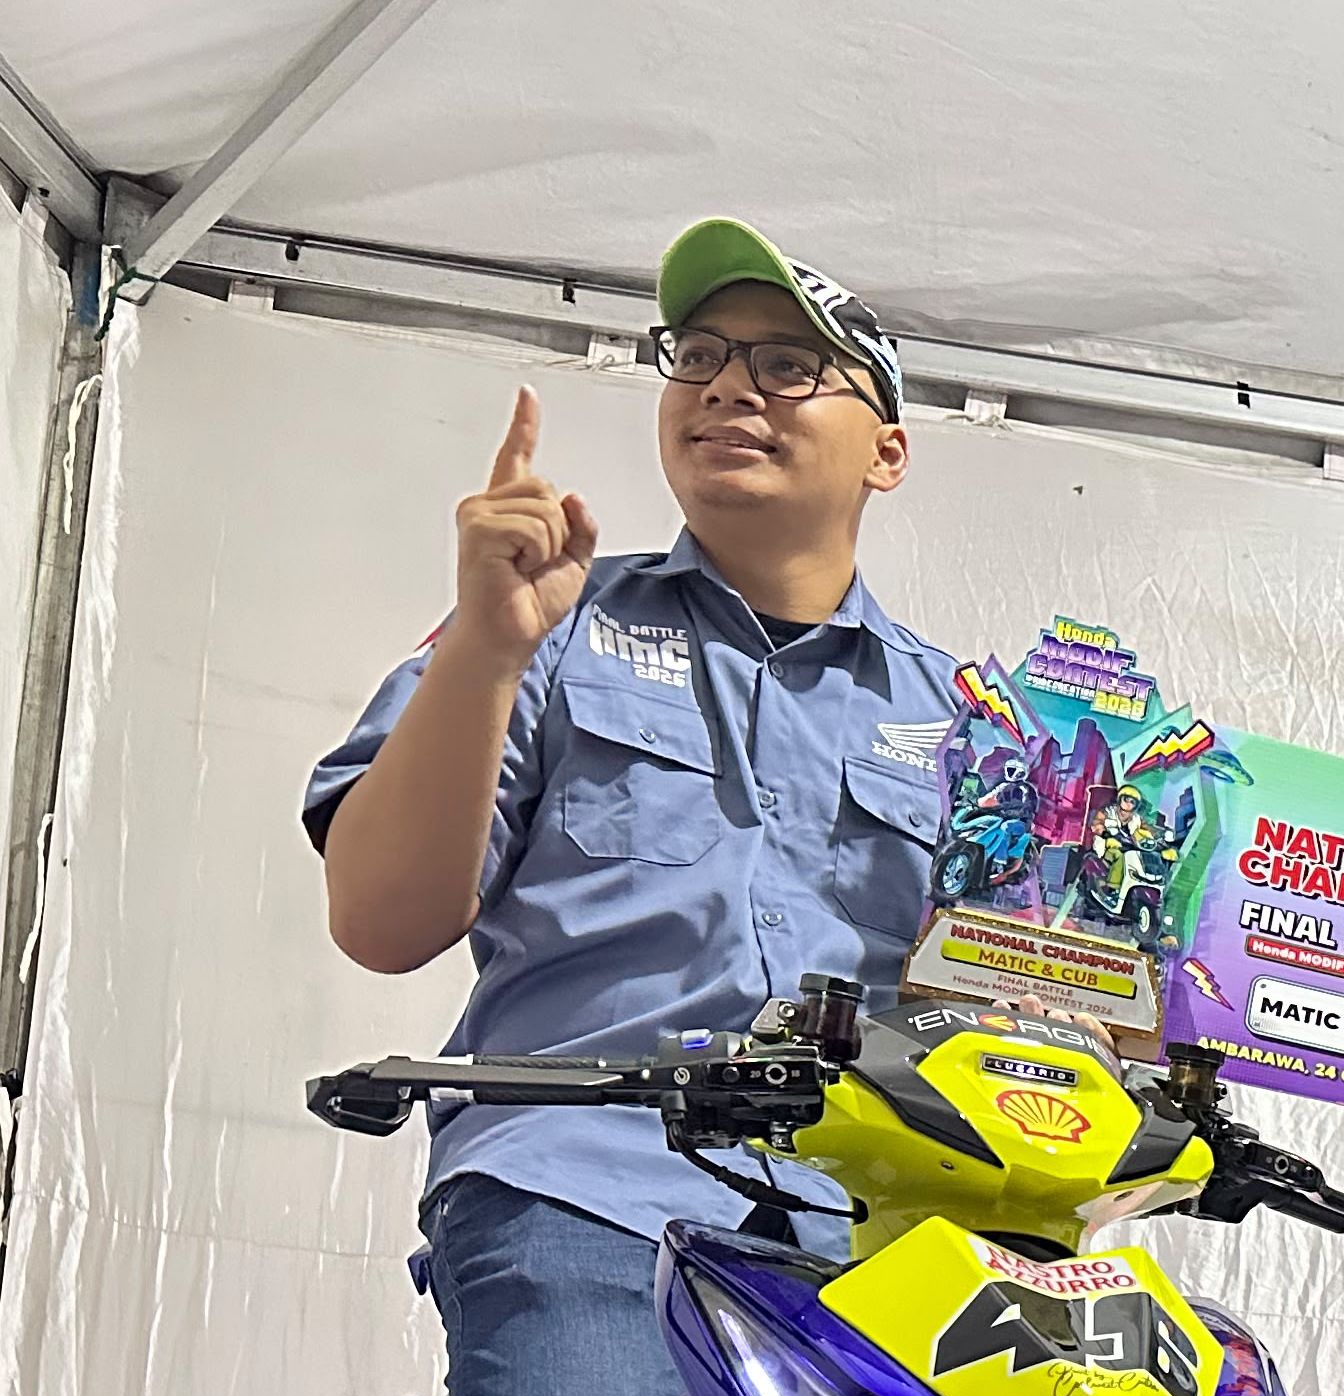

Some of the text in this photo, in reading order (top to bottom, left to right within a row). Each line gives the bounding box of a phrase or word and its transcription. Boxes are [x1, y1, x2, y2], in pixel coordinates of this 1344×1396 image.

[589, 615, 691, 672] HMC
[628, 624, 688, 640] BATTLE
[1056, 620, 1118, 650] Honda
[1041, 634, 1134, 674] MODIF
[1027, 653, 1154, 702] CONTEST
[1239, 900, 1339, 951] FINAL
[951, 923, 1135, 976] NATIONAL CHAMPION
[978, 948, 1099, 987] MATIC & CUB
[1252, 939, 1296, 961] Honda
[1298, 948, 1344, 972] MODIF
[952, 974, 990, 990] Honda
[997, 974, 1074, 997] FINAL BATTLE
[1260, 997, 1340, 1031] MATIC
[1196, 1036, 1310, 1076] AMBARAWA,
[1314, 1060, 1338, 1080] 24
[987, 1244, 1116, 1280] NASTRO
